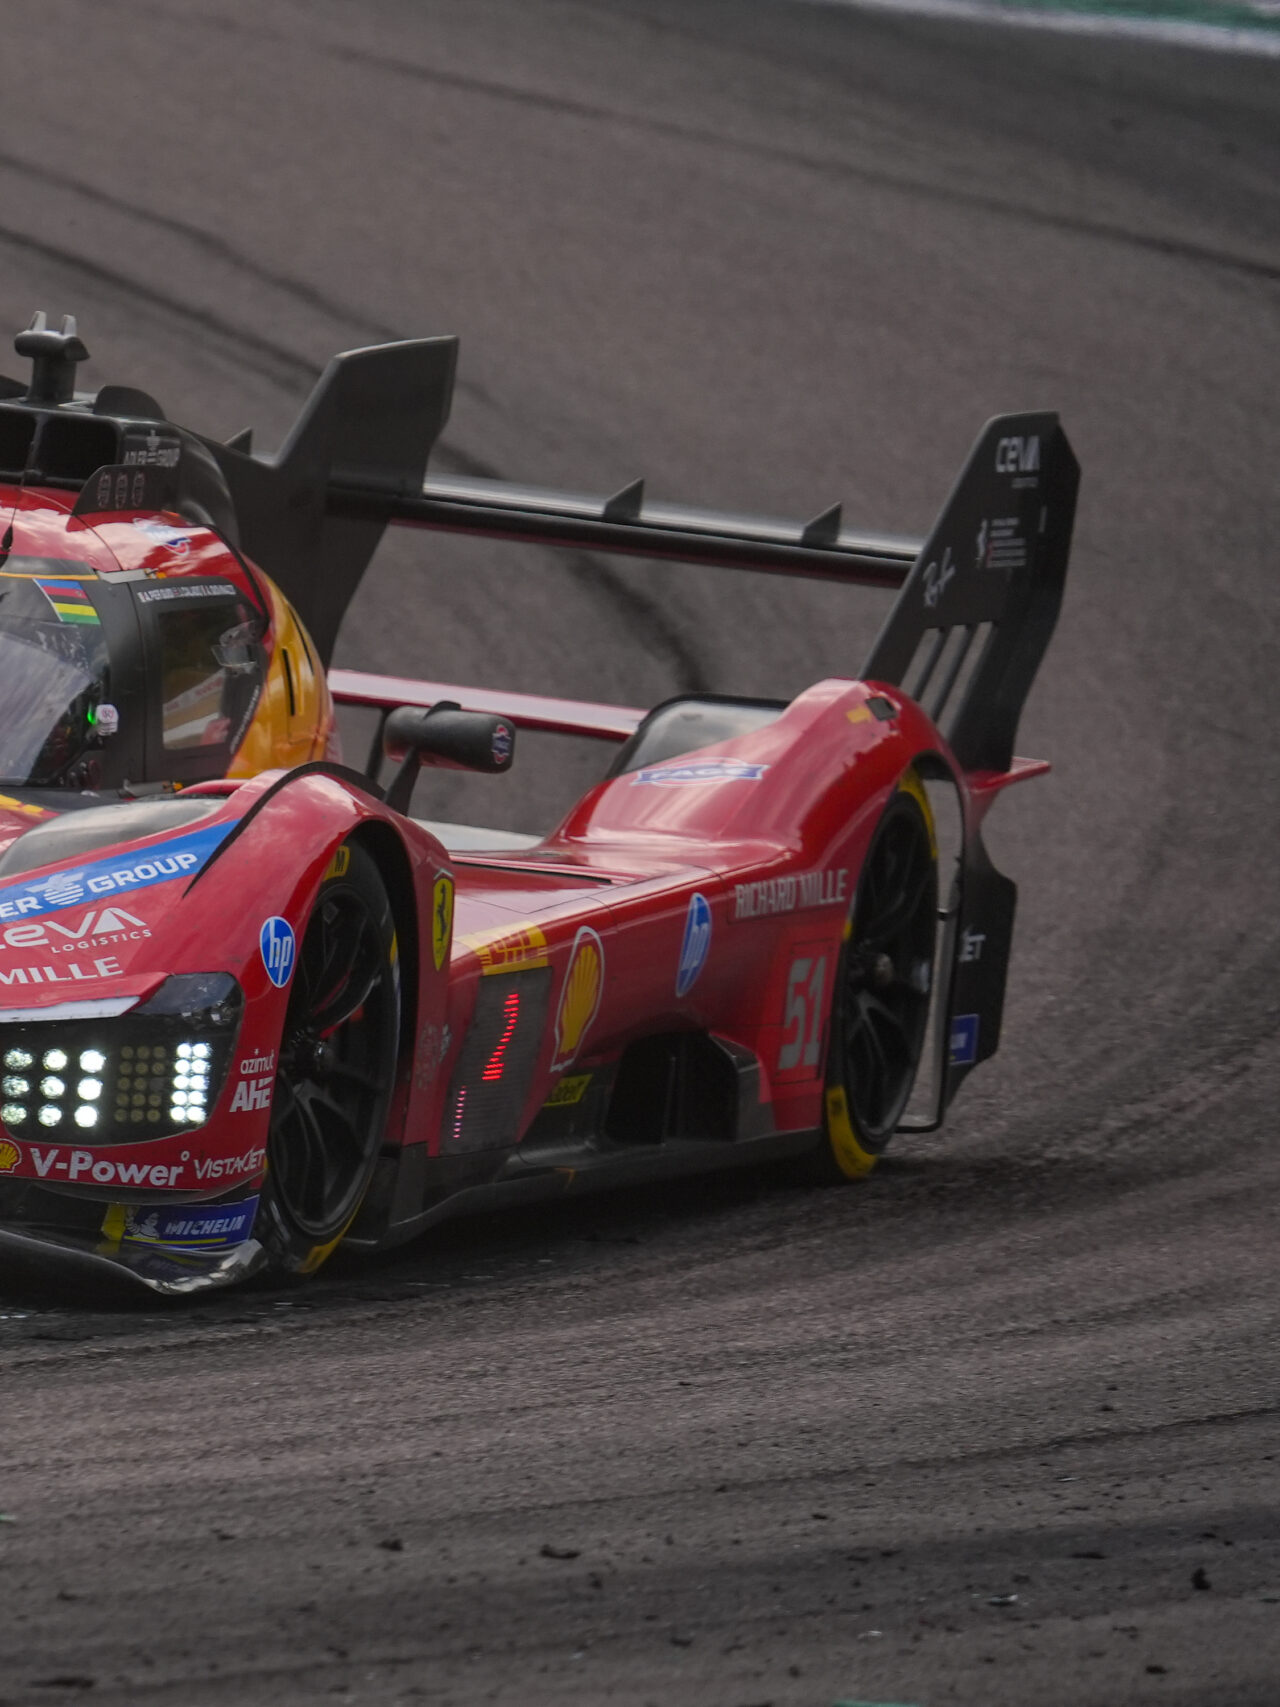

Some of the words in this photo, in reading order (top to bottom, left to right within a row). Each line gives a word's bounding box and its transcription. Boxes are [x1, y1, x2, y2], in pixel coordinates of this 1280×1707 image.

[87, 852, 200, 895] GROUP
[734, 876, 796, 919] RICHARD
[49, 928, 153, 955] LOGISTICS
[777, 955, 828, 1070] 51
[29, 1147, 184, 1187] V-Power
[164, 1213, 246, 1237] MICHELIN
